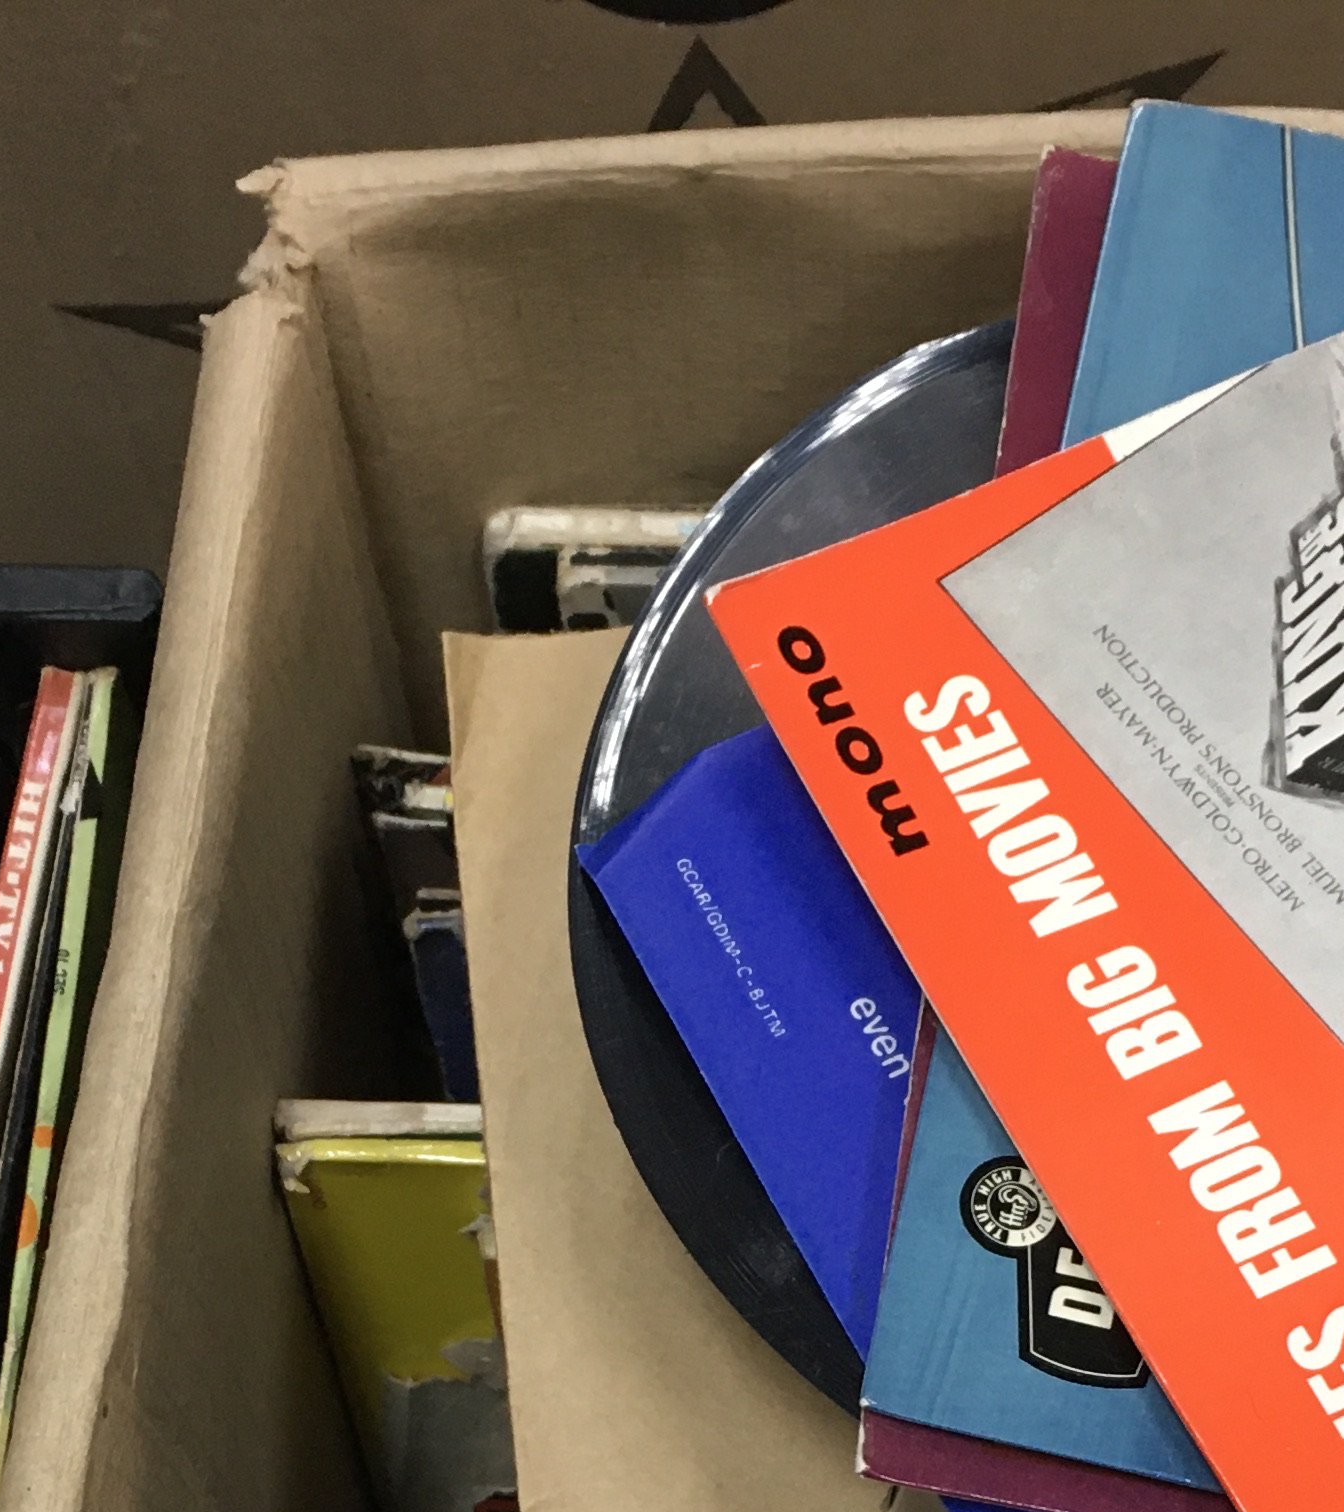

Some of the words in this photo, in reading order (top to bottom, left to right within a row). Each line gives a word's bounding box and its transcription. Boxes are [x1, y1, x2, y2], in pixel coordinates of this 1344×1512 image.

[777, 623, 929, 859] mono
[1090, 620, 1206, 748] PRODUCTION
[903, 674, 1118, 939] MOVIES
[1192, 761, 1236, 809] PRESENTS
[1197, 739, 1304, 856] BRONSTON'S
[849, 997, 911, 1079] even
[1067, 945, 1202, 1080] BIG
[972, 1200, 1010, 1242] TRUE
[978, 1168, 1014, 1195] HIGH
[1147, 1080, 1337, 1299] FROM
